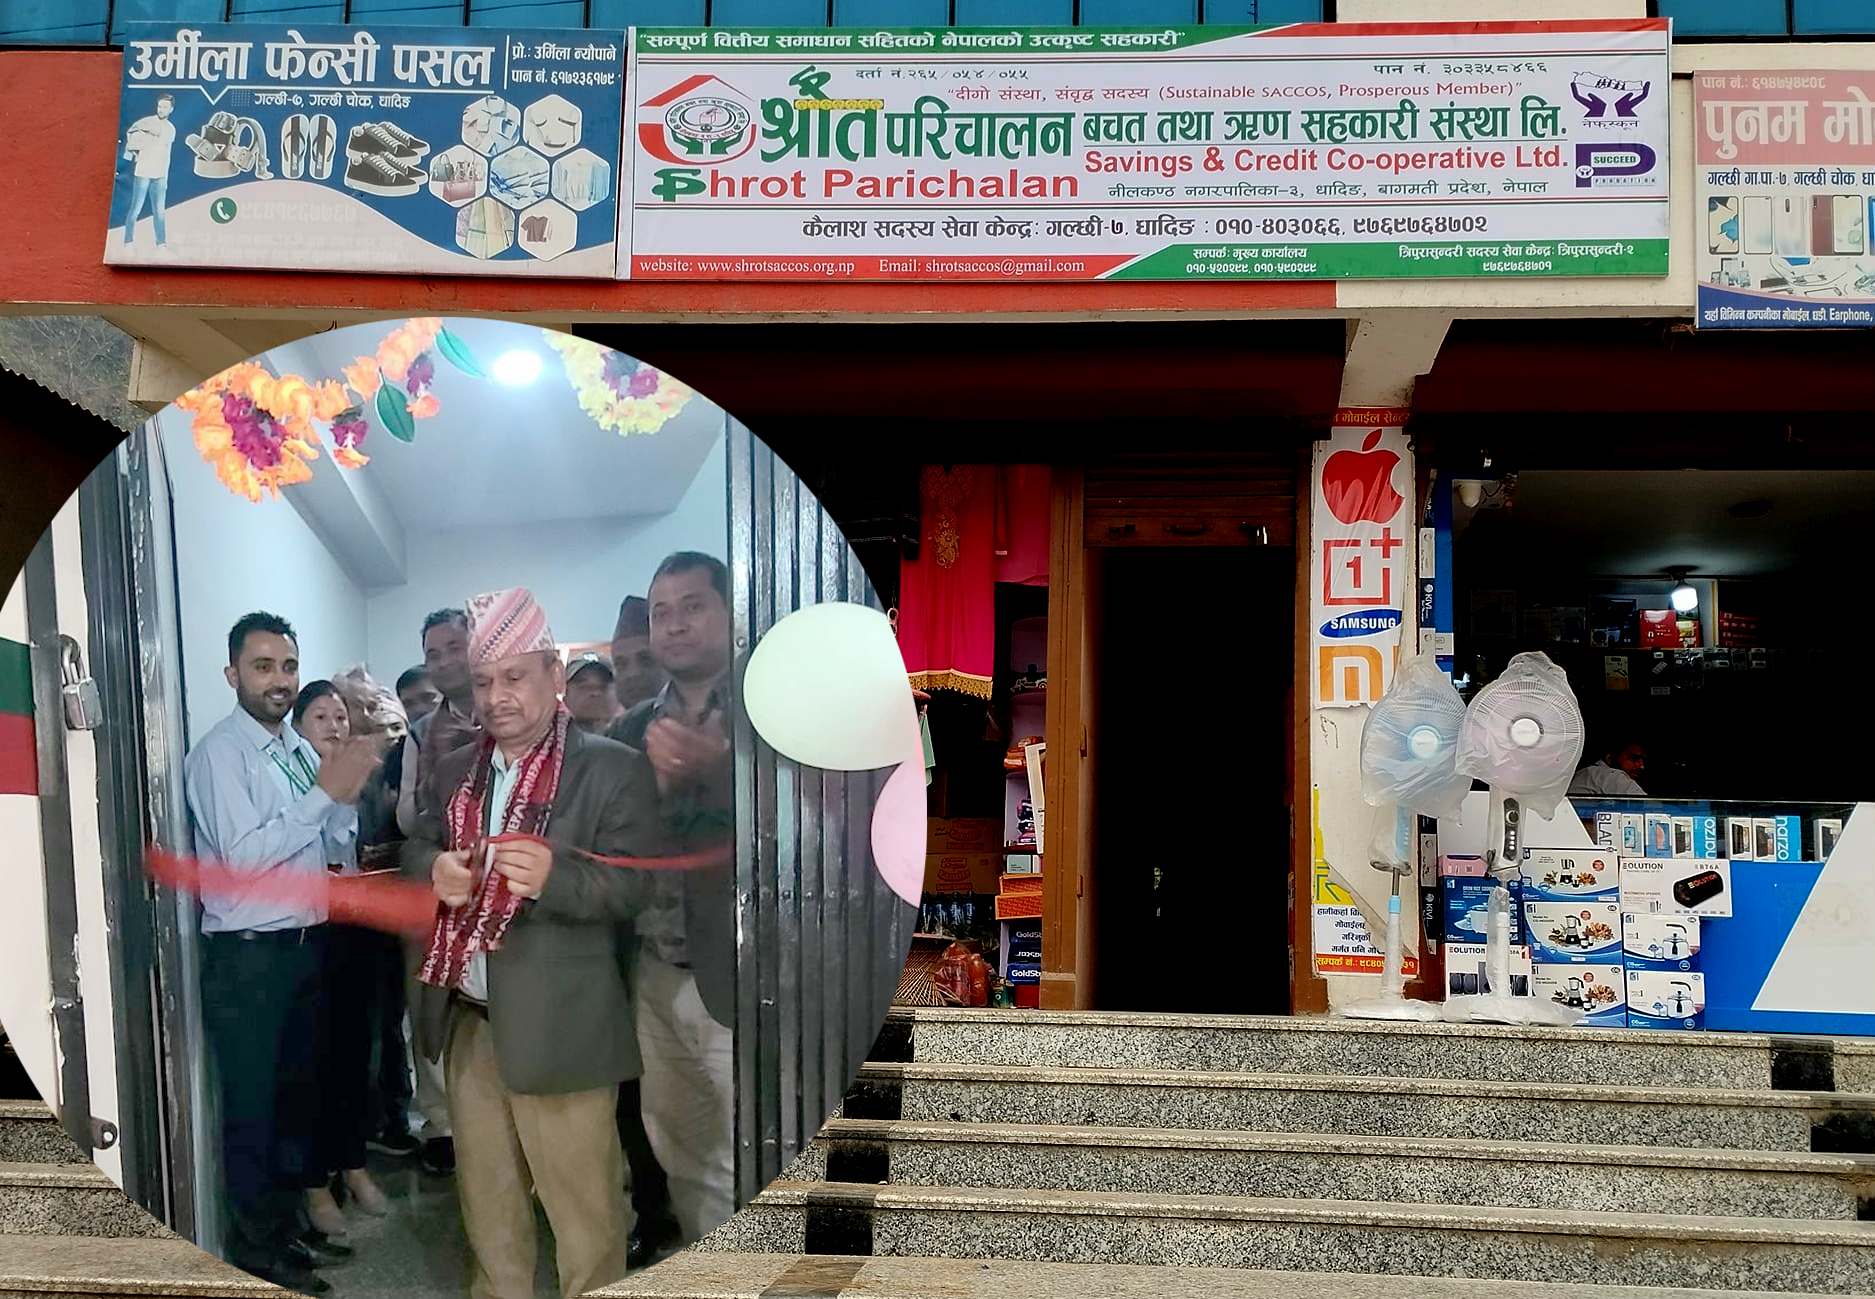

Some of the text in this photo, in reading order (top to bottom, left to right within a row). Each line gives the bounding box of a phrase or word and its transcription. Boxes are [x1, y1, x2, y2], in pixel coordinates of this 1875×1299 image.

[714, 32, 769, 47] वित्तीय
[776, 34, 852, 48] समाधान
[858, 32, 936, 48] सहितको
[942, 32, 1024, 47] नेपालको
[1029, 33, 1094, 49] उत्कृष्ट
[265, 30, 380, 86] फेन्सी
[393, 44, 496, 87] पसल
[575, 43, 617, 61] न्यौपाने
[511, 69, 533, 83] पान
[856, 68, 883, 79] दर्ता
[1374, 64, 1403, 75] पान
[1702, 77, 1726, 89] पान
[1102, 88, 1150, 100] सदस्य
[1158, 85, 1255, 102] (Sustainable
[1339, 84, 1430, 99] Prosperous
[884, 96, 1076, 160] परिचालन
[1083, 112, 1148, 144] बचत
[1157, 111, 1215, 144] तथा
[1223, 110, 1292, 141] ऋण
[1300, 99, 1420, 144] सहकारी
[1430, 100, 1511, 141] संस्था
[1521, 95, 1567, 139] लि.
[1703, 86, 1875, 160] पुनम मो
[1085, 145, 1568, 178] Savings & Credit Co-operative Ltd.
[1593, 156, 1637, 164] SUCCEED
[823, 169, 1079, 200] Parichalan
[1707, 167, 1741, 186] गल्छी
[1794, 167, 1827, 186] गल्छी
[1108, 184, 1175, 197] नीलकण्ठ
[1377, 180, 1439, 195] बागमती
[1502, 178, 1549, 194] नेपाल
[802, 215, 867, 237] कैलाश
[873, 219, 936, 238] सदस्य
[941, 215, 979, 237] सेवा
[1353, 215, 1488, 236] ९७६९७६४७०२
[1232, 249, 1258, 260] मुख्य
[1261, 247, 1307, 259] कार्यालय
[1466, 246, 1499, 257] सदस्य
[1502, 244, 1522, 256] सेवा
[640, 258, 1085, 275] website: www.shrotsaccos.org.np Email: shrotsaccos@gmail.com
[1829, 307, 1873, 324] Earphone,
[1330, 617, 1396, 630] SAMSUNG
[1703, 818, 1716, 860] narzo
[1776, 816, 1790, 861] narzo
